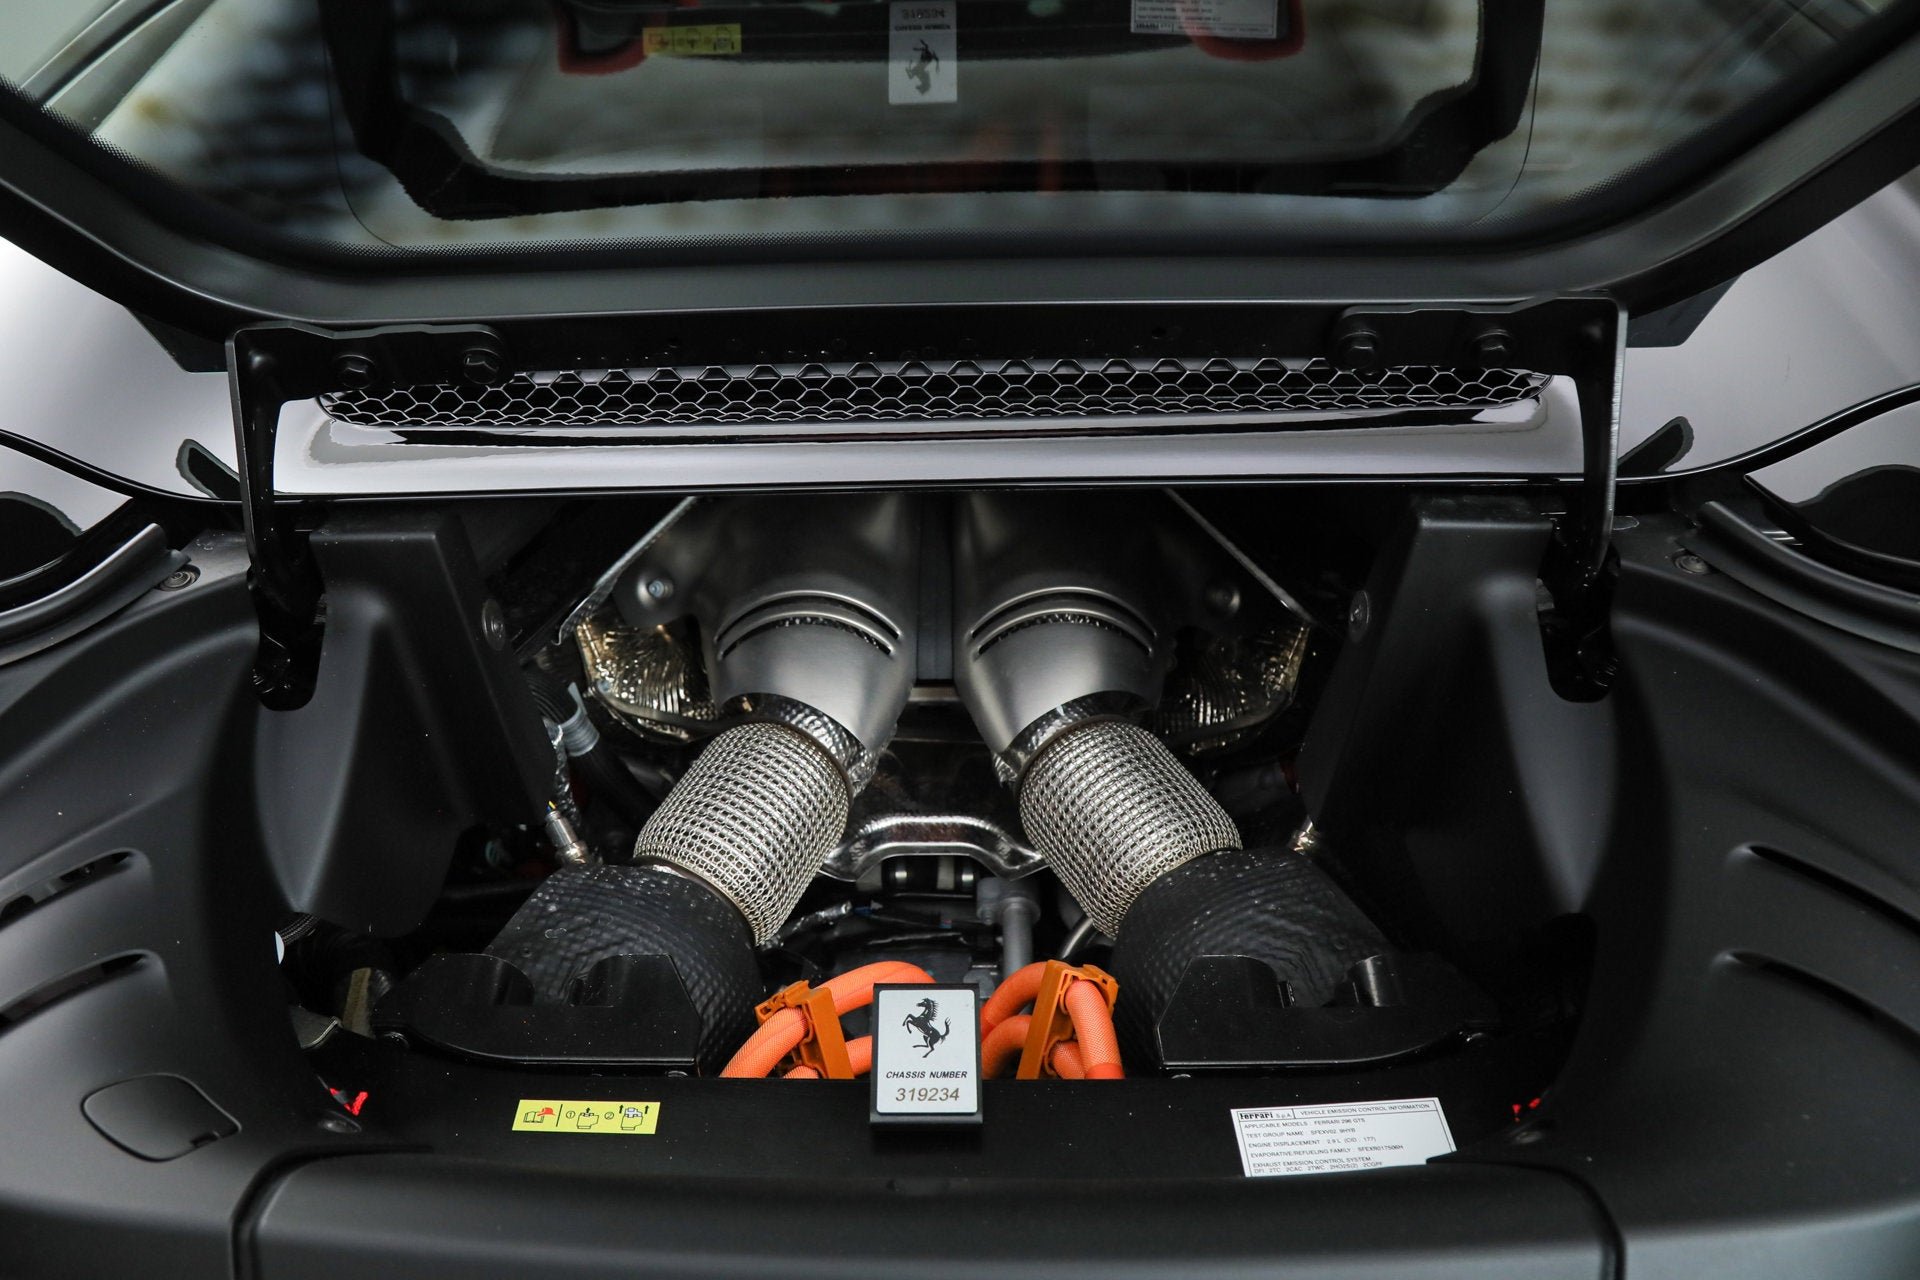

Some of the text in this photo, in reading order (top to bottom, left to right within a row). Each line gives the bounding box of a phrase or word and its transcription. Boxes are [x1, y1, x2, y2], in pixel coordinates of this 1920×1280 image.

[886, 1071, 968, 1079] CHASSIS NUMBER
[896, 1087, 960, 1102] 319234
